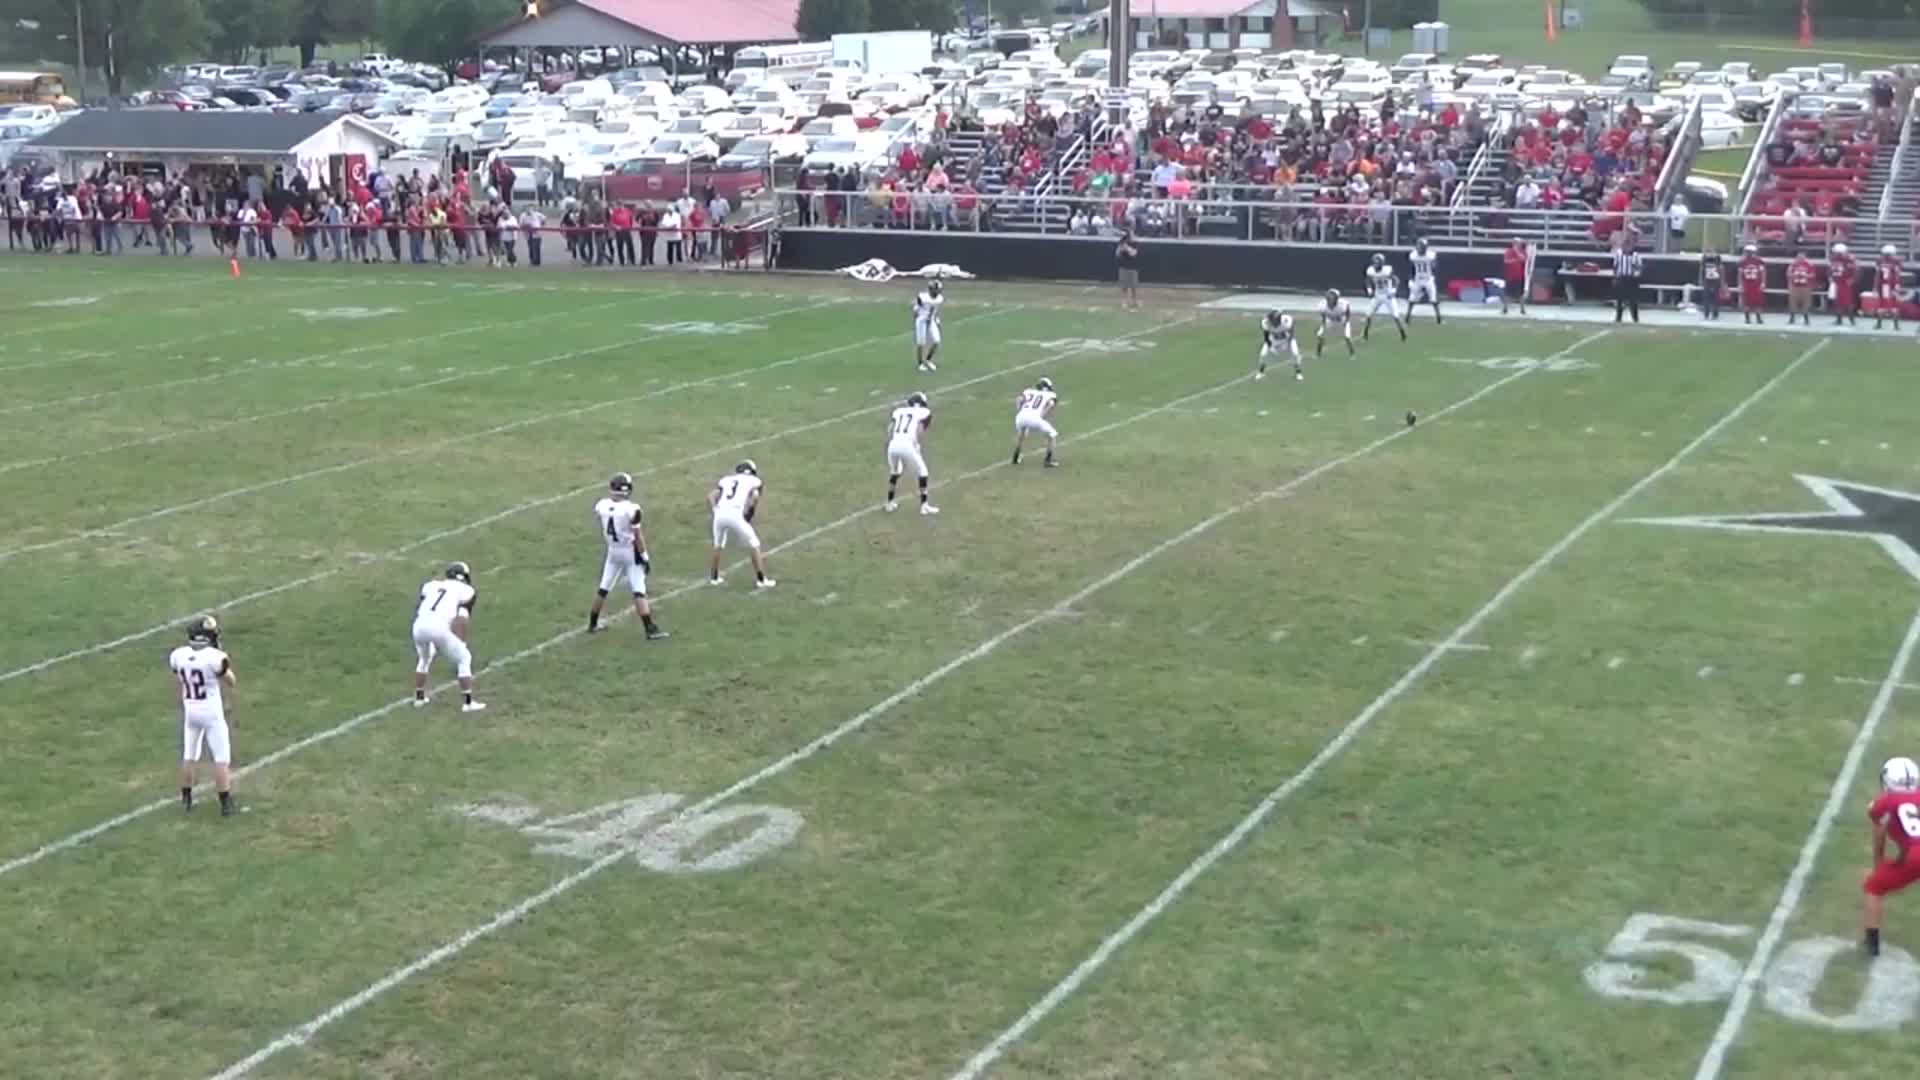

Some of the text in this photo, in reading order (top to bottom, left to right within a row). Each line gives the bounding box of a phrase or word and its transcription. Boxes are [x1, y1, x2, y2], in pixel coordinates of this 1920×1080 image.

[1023, 393, 1043, 409] 20
[895, 413, 913, 433] 17
[726, 479, 739, 500] 3
[607, 516, 619, 542] 4
[430, 587, 447, 612] 7
[180, 668, 207, 700] 12
[519, 793, 806, 873] 40
[1582, 911, 1920, 1033] 50
